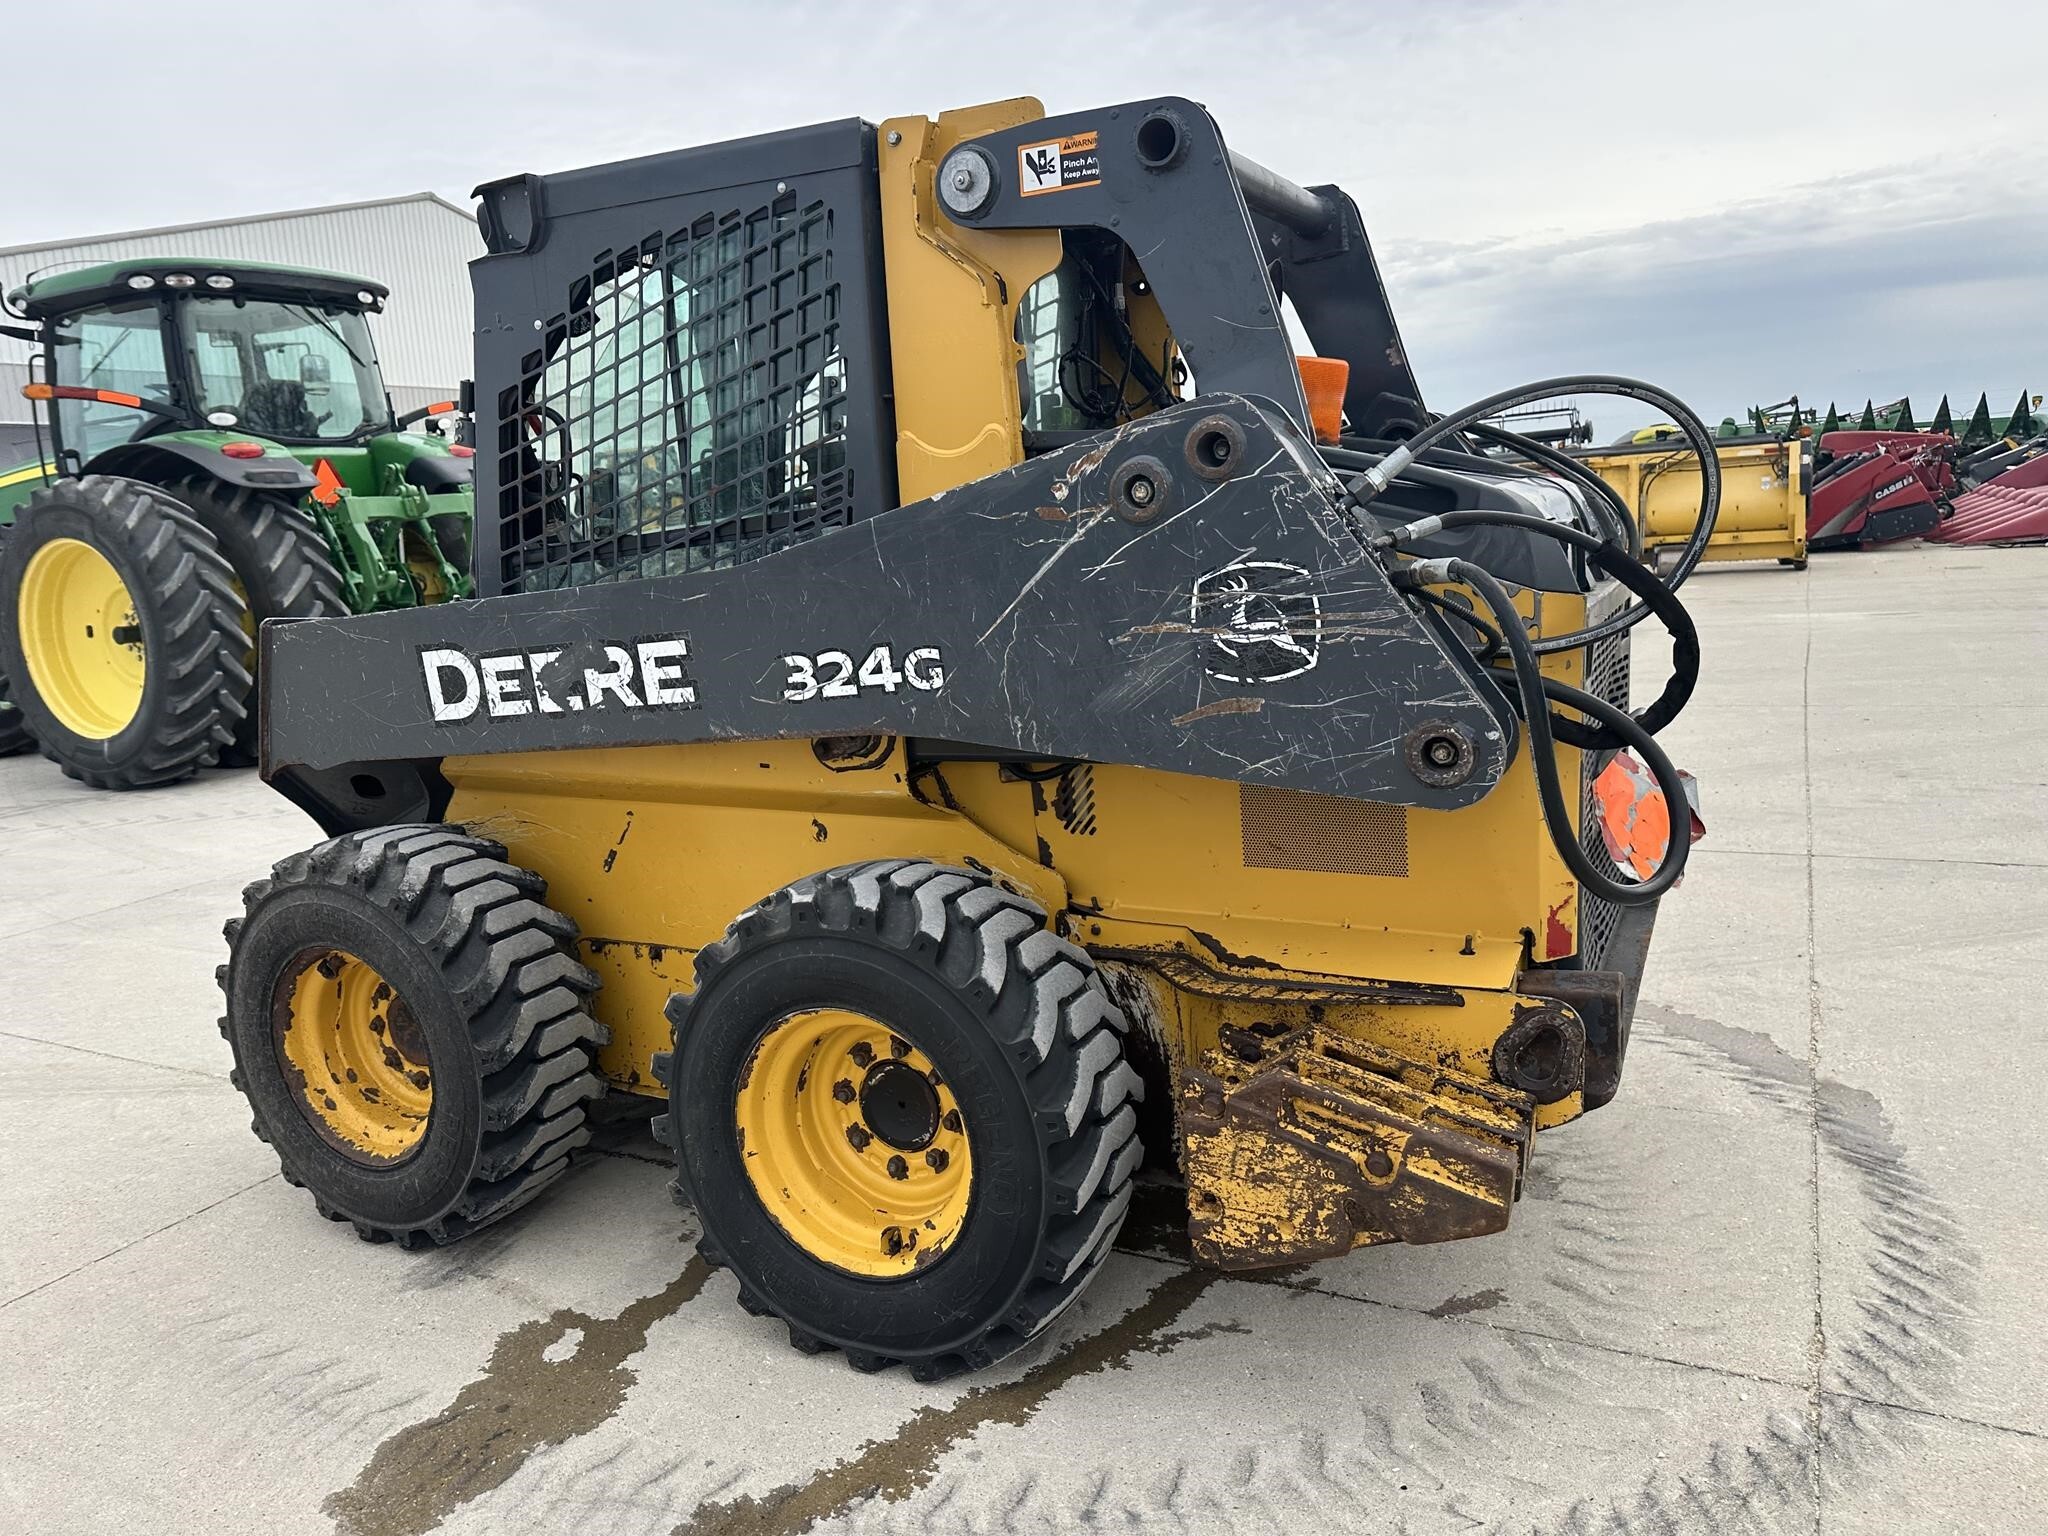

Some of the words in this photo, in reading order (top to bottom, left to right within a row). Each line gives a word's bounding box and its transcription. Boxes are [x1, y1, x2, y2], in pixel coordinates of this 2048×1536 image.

[1063, 158, 1085, 169] Pinch
[1063, 170, 1081, 179] Keep
[1081, 168, 1099, 176] Away
[1875, 480, 1903, 499] CASE
[782, 645, 945, 702] 324G
[1302, 1163, 1317, 1174] 39
[1320, 1166, 1336, 1180] KG
